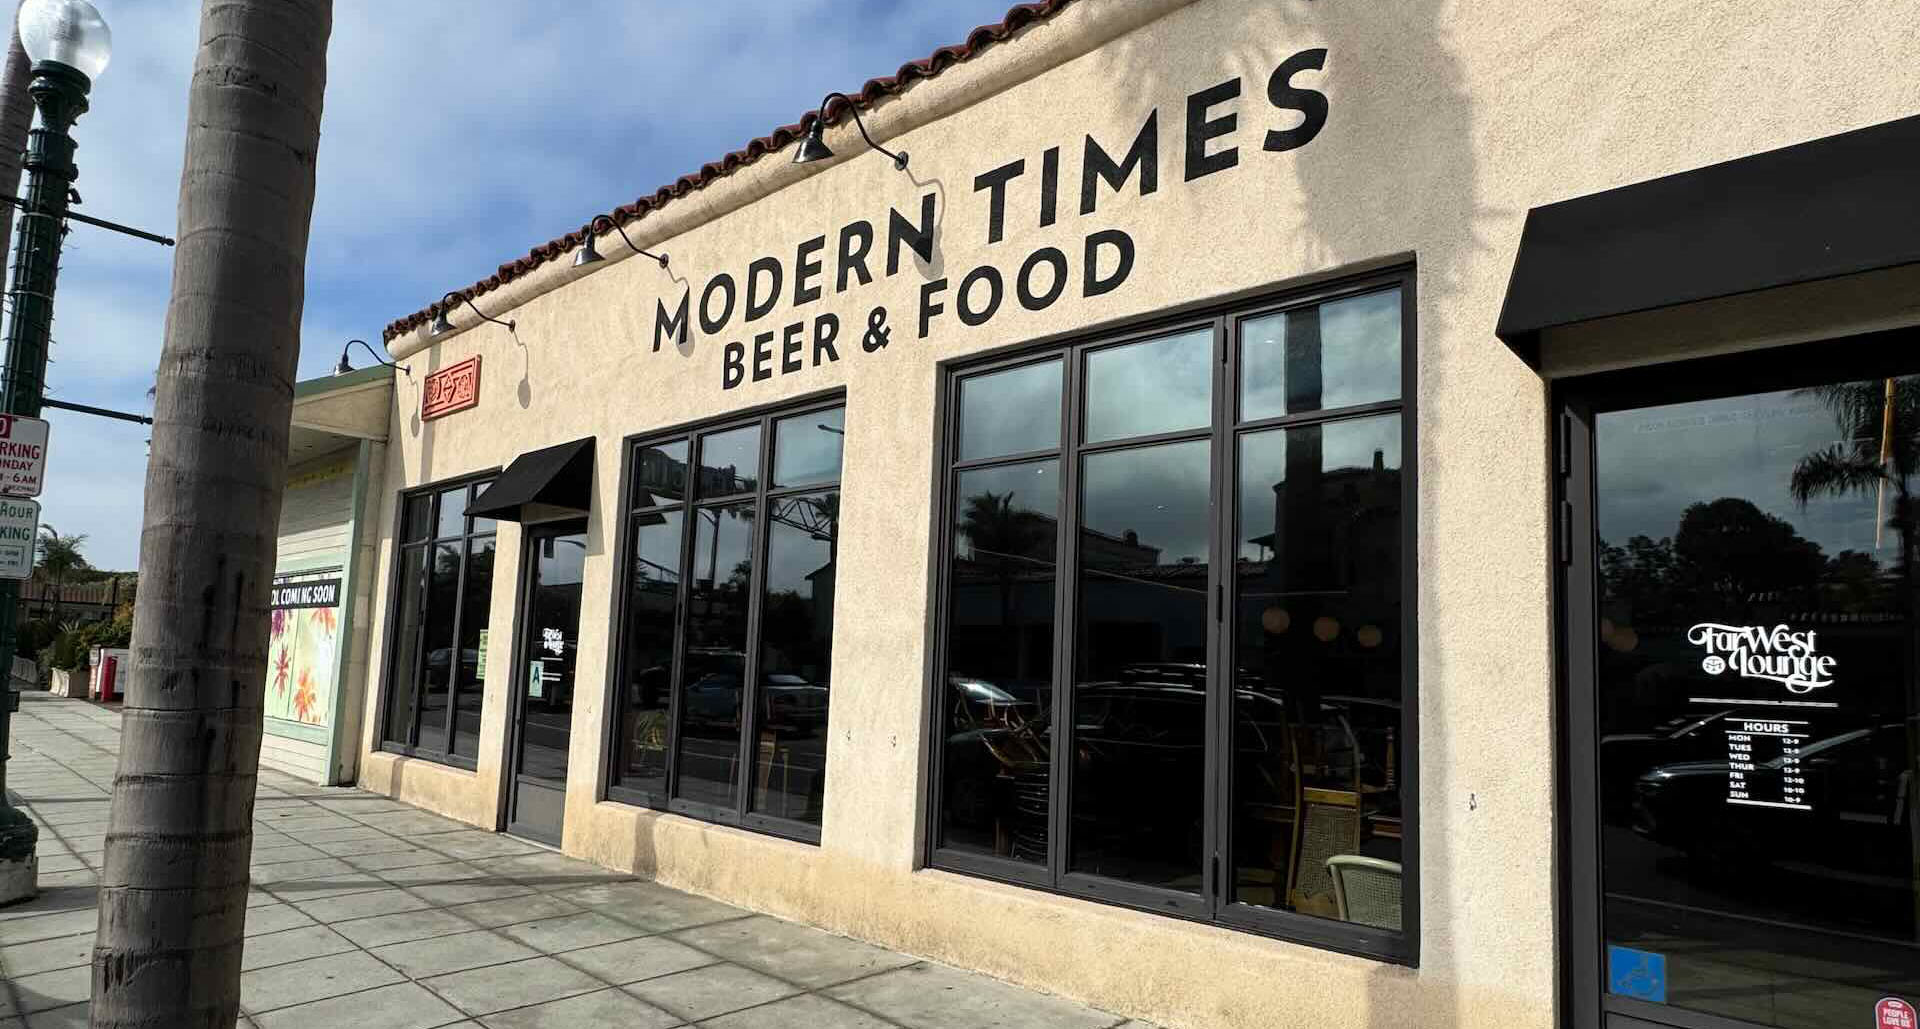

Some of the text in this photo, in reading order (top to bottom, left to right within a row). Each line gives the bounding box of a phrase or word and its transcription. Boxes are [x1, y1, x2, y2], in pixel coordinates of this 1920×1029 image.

[652, 48, 1329, 353] MODERN TIMES
[723, 227, 1136, 391] BEER & FOOD
[0, 441, 41, 460] RKING
[0, 525, 31, 541] KING
[280, 586, 313, 606] COMING
[312, 584, 336, 604] SOON
[1688, 622, 1817, 658] Far West
[532, 666, 540, 685] A
[1728, 646, 1837, 694] Lounge
[1743, 722, 1789, 734] HOURS
[1728, 734, 1751, 742] MON
[1728, 743, 1752, 752] TUES
[1728, 752, 1750, 761] WED
[1728, 762, 1755, 771] THUR
[1729, 771, 1744, 780] FRI
[1729, 781, 1746, 789] SAT
[1729, 790, 1749, 798] SUN
